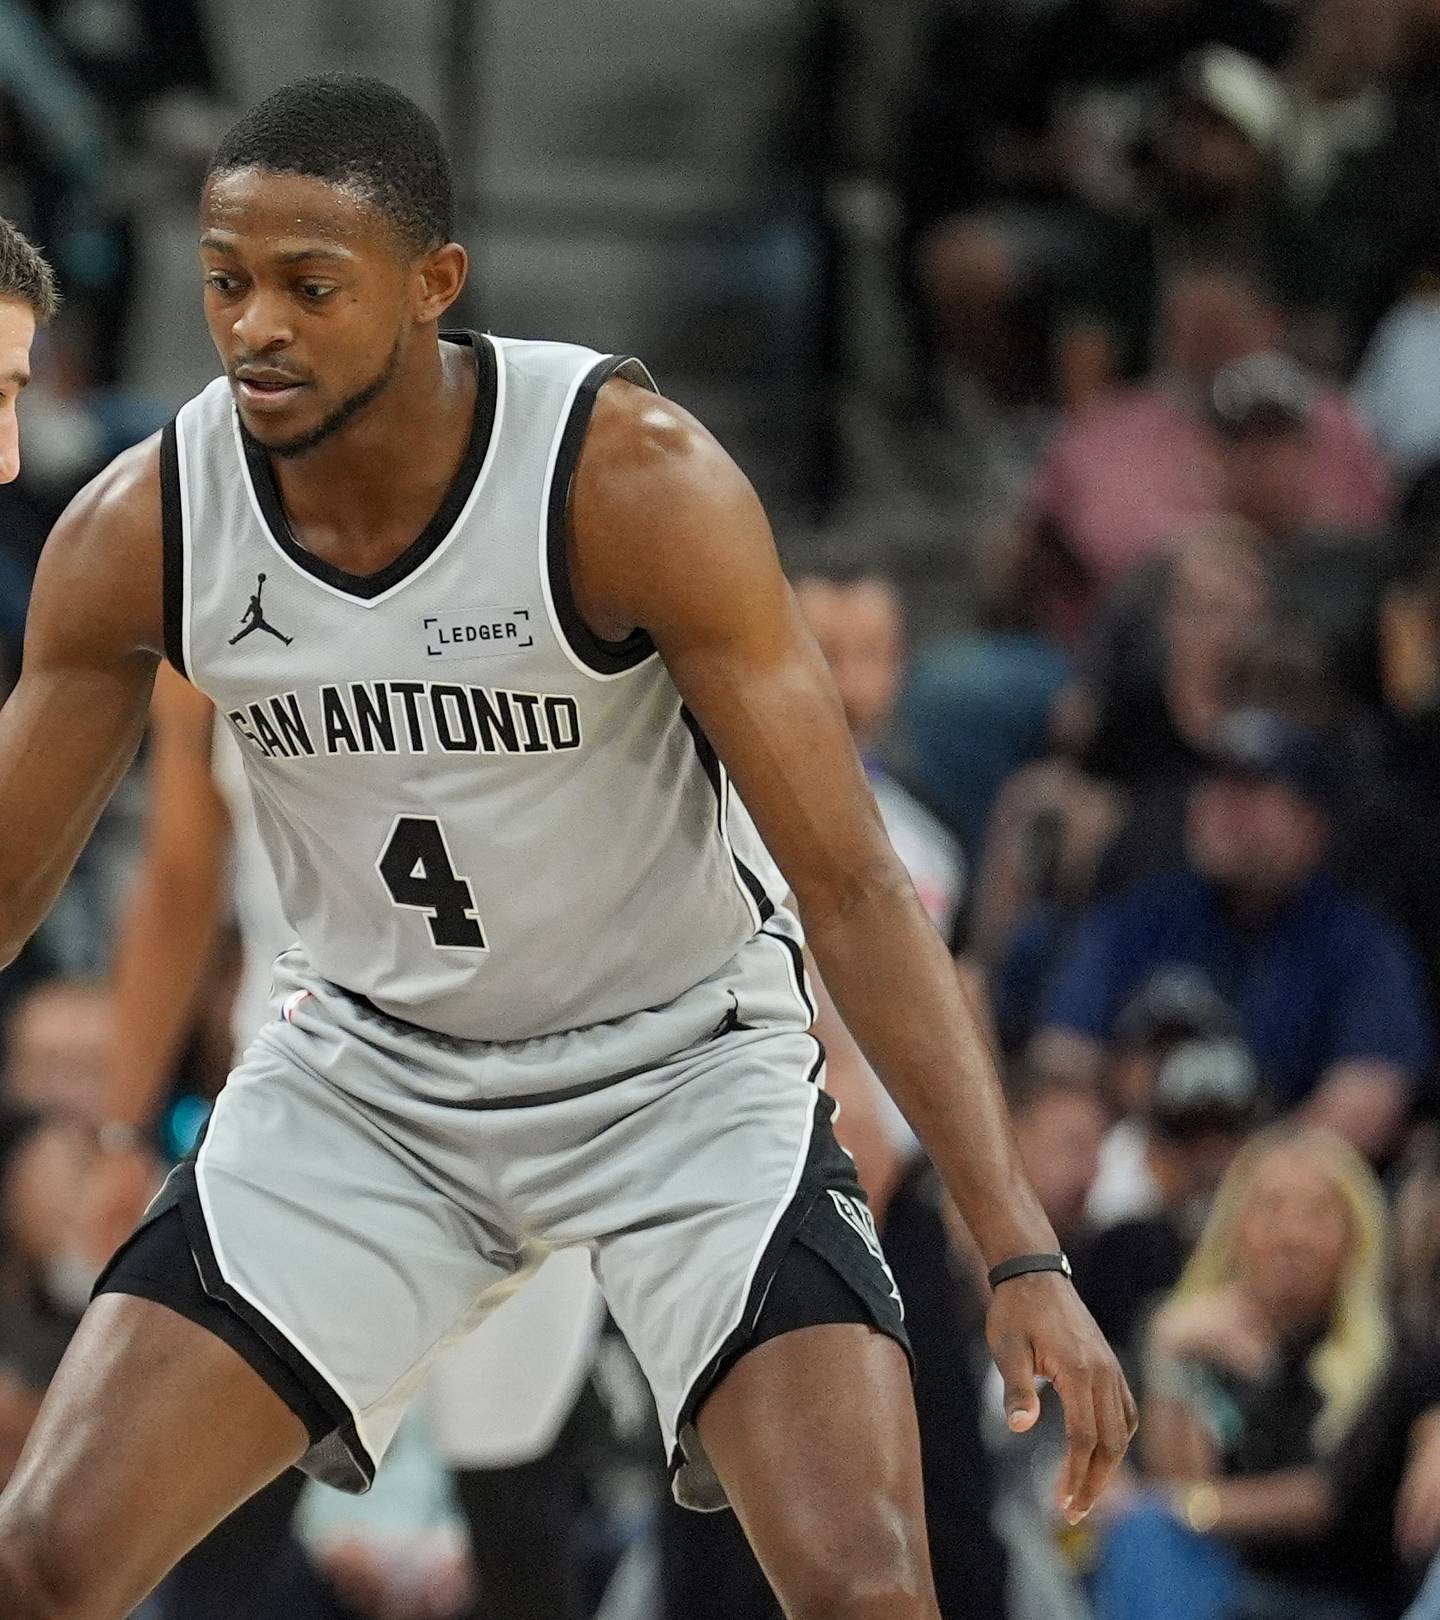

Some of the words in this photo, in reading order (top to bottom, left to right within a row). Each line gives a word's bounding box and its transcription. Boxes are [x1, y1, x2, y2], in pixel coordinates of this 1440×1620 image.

[437, 621, 519, 645] LEDGER
[225, 690, 317, 760] SAN
[319, 679, 582, 755] ANTONIO
[374, 813, 491, 953] 4
